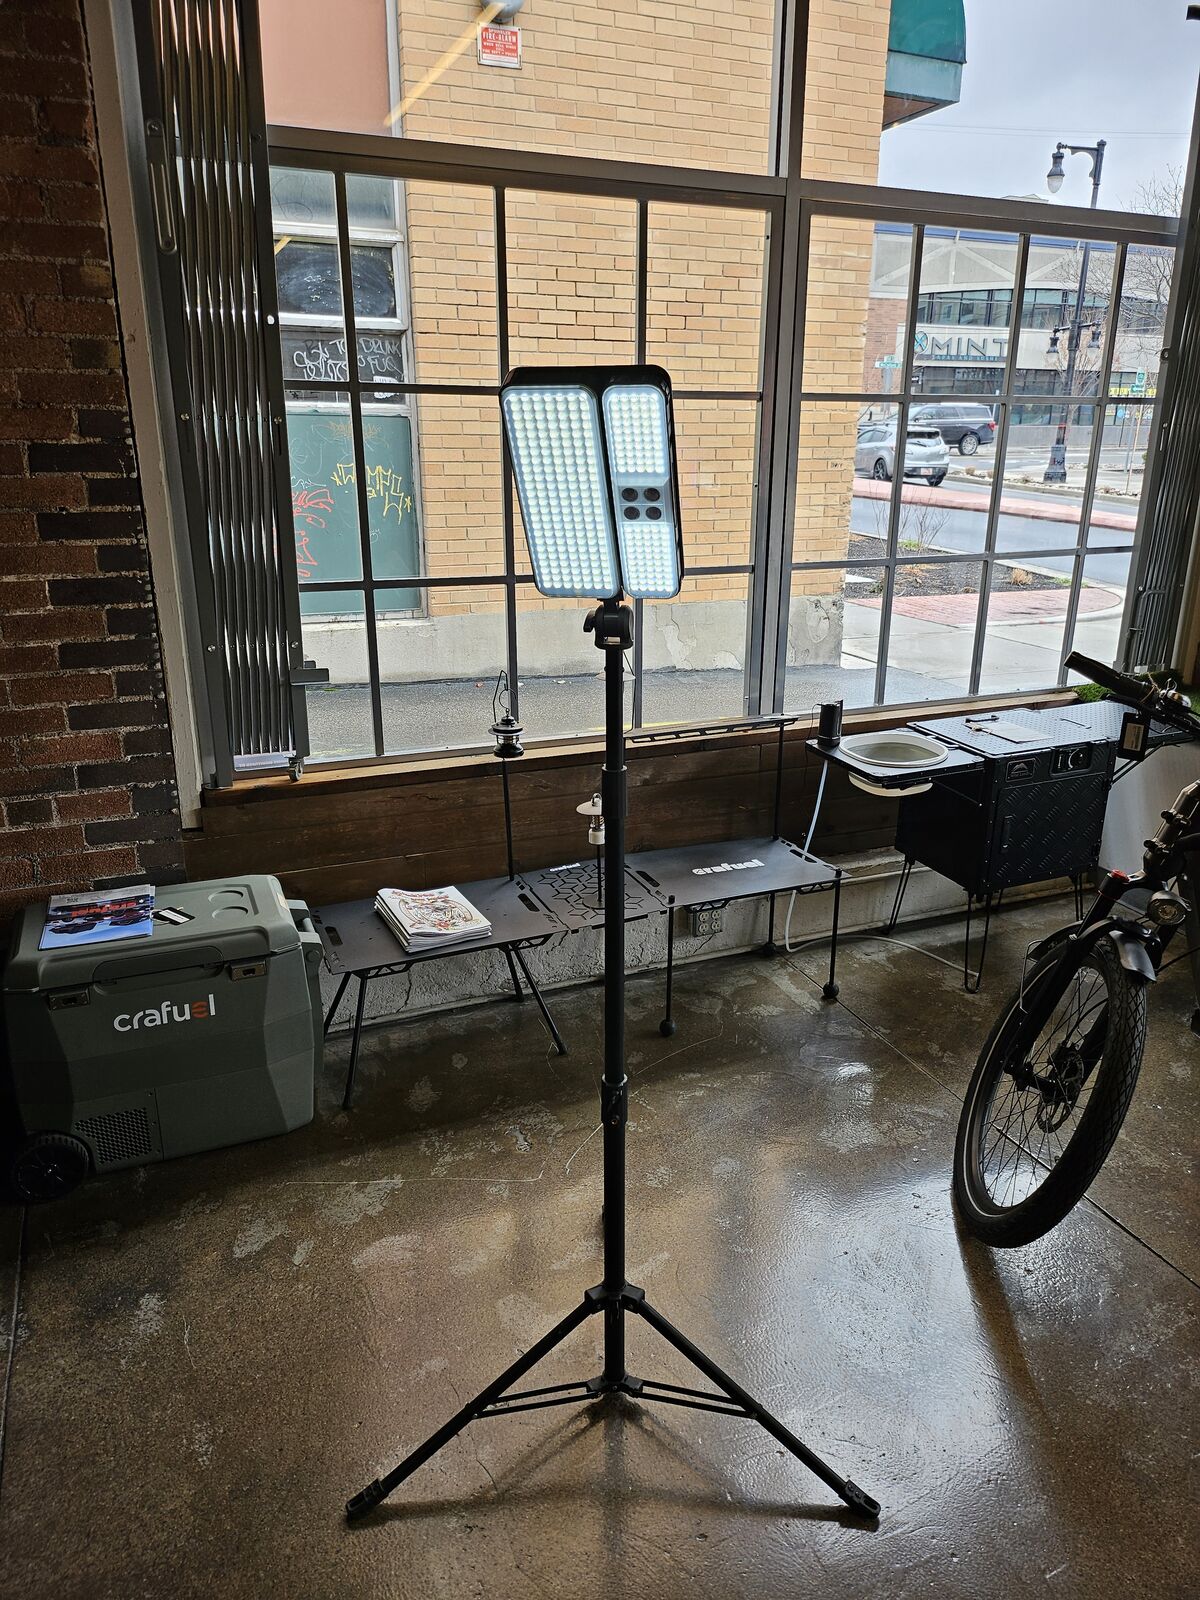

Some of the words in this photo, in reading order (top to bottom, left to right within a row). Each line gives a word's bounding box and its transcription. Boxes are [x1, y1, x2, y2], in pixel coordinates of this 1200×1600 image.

[931, 336, 1008, 357] MINT
[692, 859, 766, 875] crafuel
[113, 993, 217, 1032] crafuel
